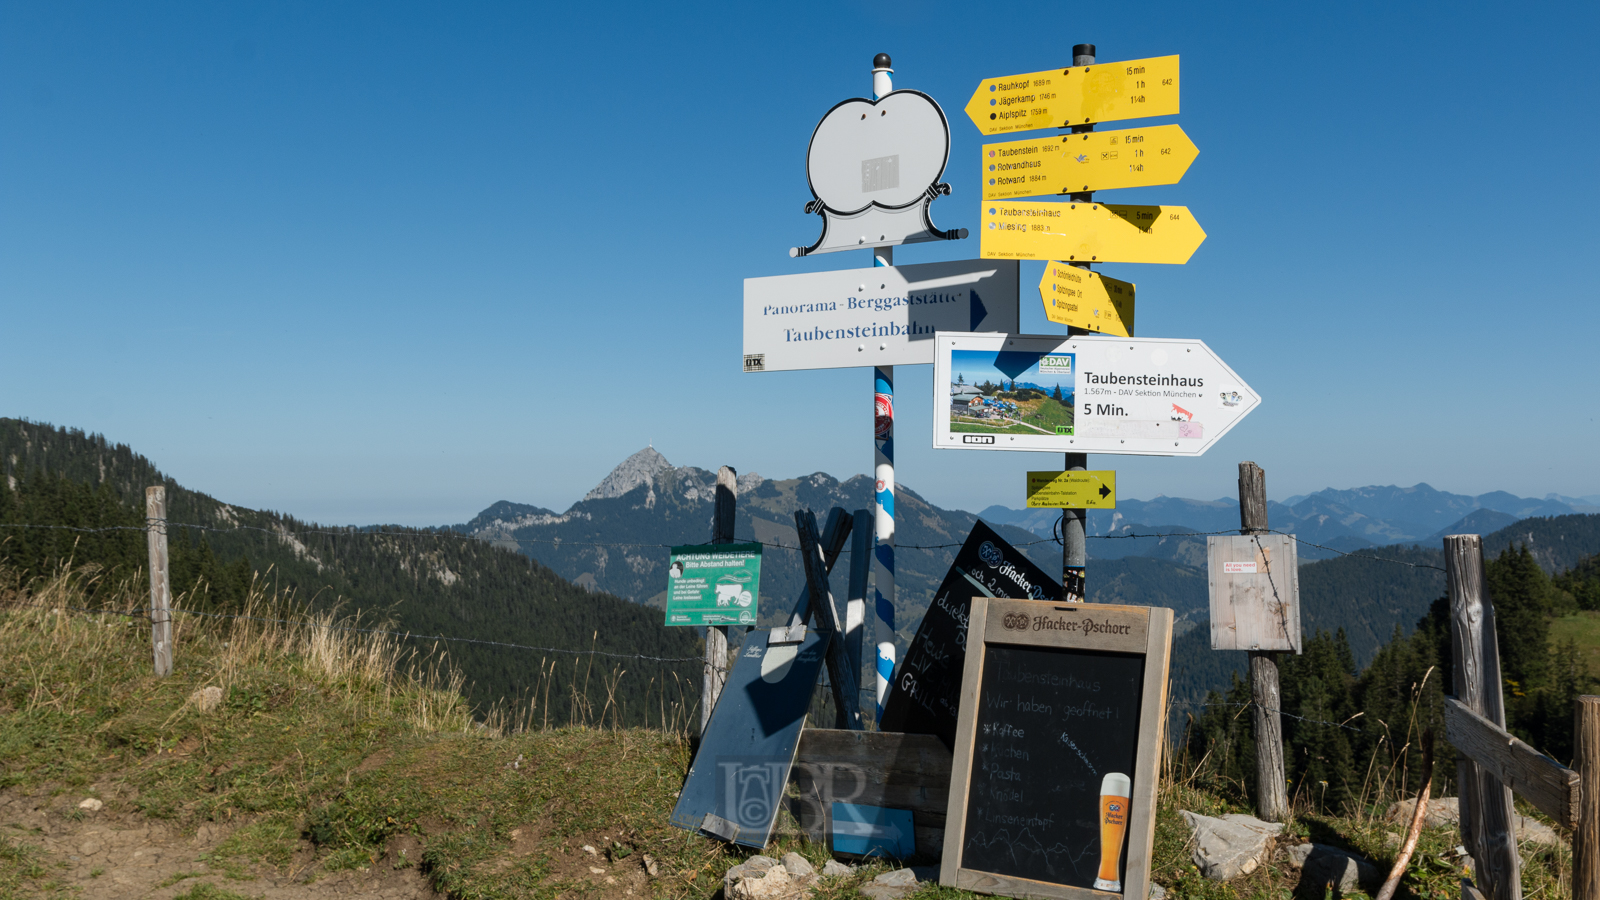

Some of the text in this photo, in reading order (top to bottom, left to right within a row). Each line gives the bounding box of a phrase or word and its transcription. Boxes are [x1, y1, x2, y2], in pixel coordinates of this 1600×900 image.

[1126, 66, 1145, 75] 15 min
[998, 80, 1030, 91] Rauhkopf
[1162, 78, 1172, 86] 642
[998, 94, 1036, 106] Jägerkamp
[998, 109, 1027, 120] Aiplspitz
[1125, 135, 1144, 144] 15 min
[998, 146, 1038, 157] Taubenstein
[998, 160, 1041, 171] Rotwandhaus
[998, 175, 1025, 185] Rotwand
[999, 207, 1061, 217] Taubensteinhaus
[1136, 211, 1140, 220] 5
[998, 222, 1026, 232] Miesing
[784, 322, 935, 342] Taubensteinbahn
[1049, 358, 1069, 366] DAV
[1084, 372, 1204, 387] Taubensteinhaus
[1084, 404, 1128, 416] 5 Min.
[676, 550, 755, 561] ACHTUNG WEIDETIERE
[987, 578, 997, 592] 2
[1033, 616, 1130, 636] Hacker-Pschorr
[991, 659, 1101, 693] Taubensteinhaus
[986, 691, 1008, 708] Wir
[1017, 696, 1052, 715] haben
[990, 764, 1021, 781] Pasta
[985, 807, 1054, 831] Linseneintopf
